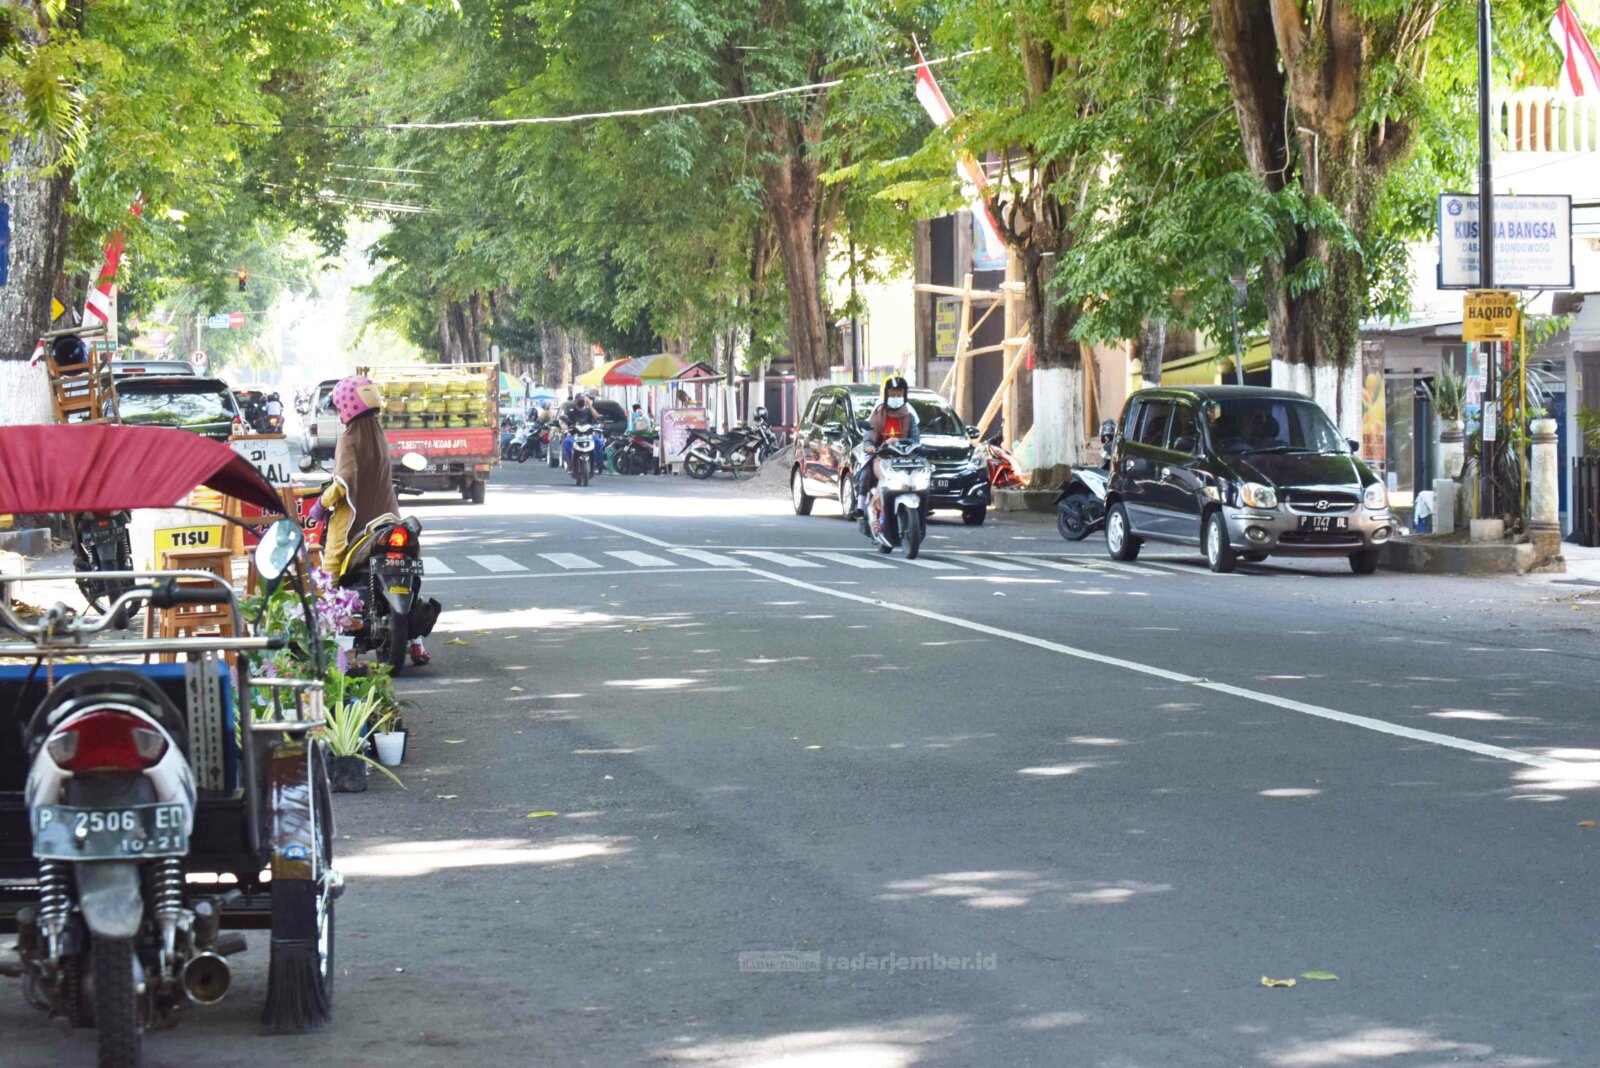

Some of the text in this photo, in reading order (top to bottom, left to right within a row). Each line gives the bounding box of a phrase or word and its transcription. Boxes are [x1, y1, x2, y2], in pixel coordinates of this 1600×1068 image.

[1508, 222, 1556, 239] BANGSA
[1500, 243, 1550, 253] BONDOWOSO
[1468, 306, 1513, 321] HAQIRO
[250, 450, 266, 461] DI
[1301, 516, 1307, 526] P
[171, 531, 209, 546] TISU
[371, 558, 378, 566] P
[39, 806, 183, 832] P 2506 ED
